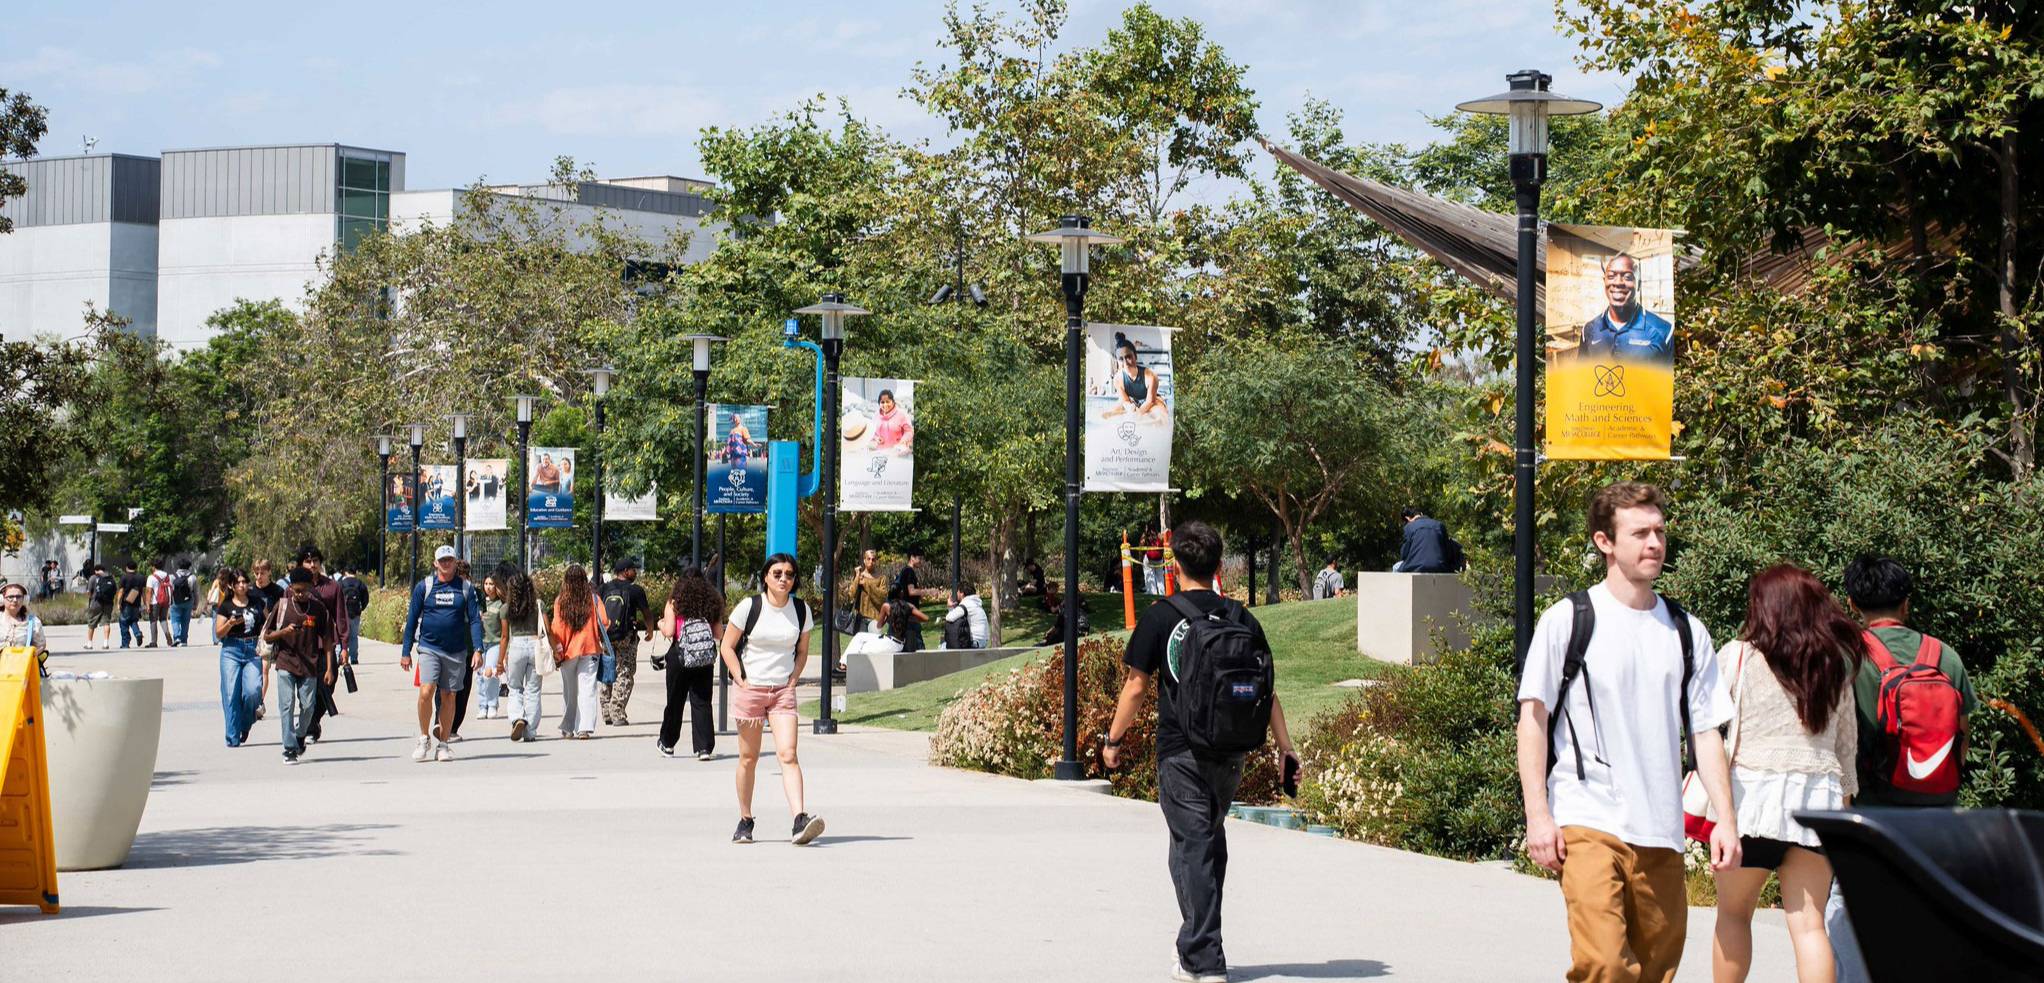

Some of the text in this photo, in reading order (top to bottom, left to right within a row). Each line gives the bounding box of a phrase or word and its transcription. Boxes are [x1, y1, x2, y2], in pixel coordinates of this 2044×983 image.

[1565, 413, 1653, 423] Math and Sciences
[1124, 448, 1148, 457] Design
[1100, 456, 1156, 464] and Performance
